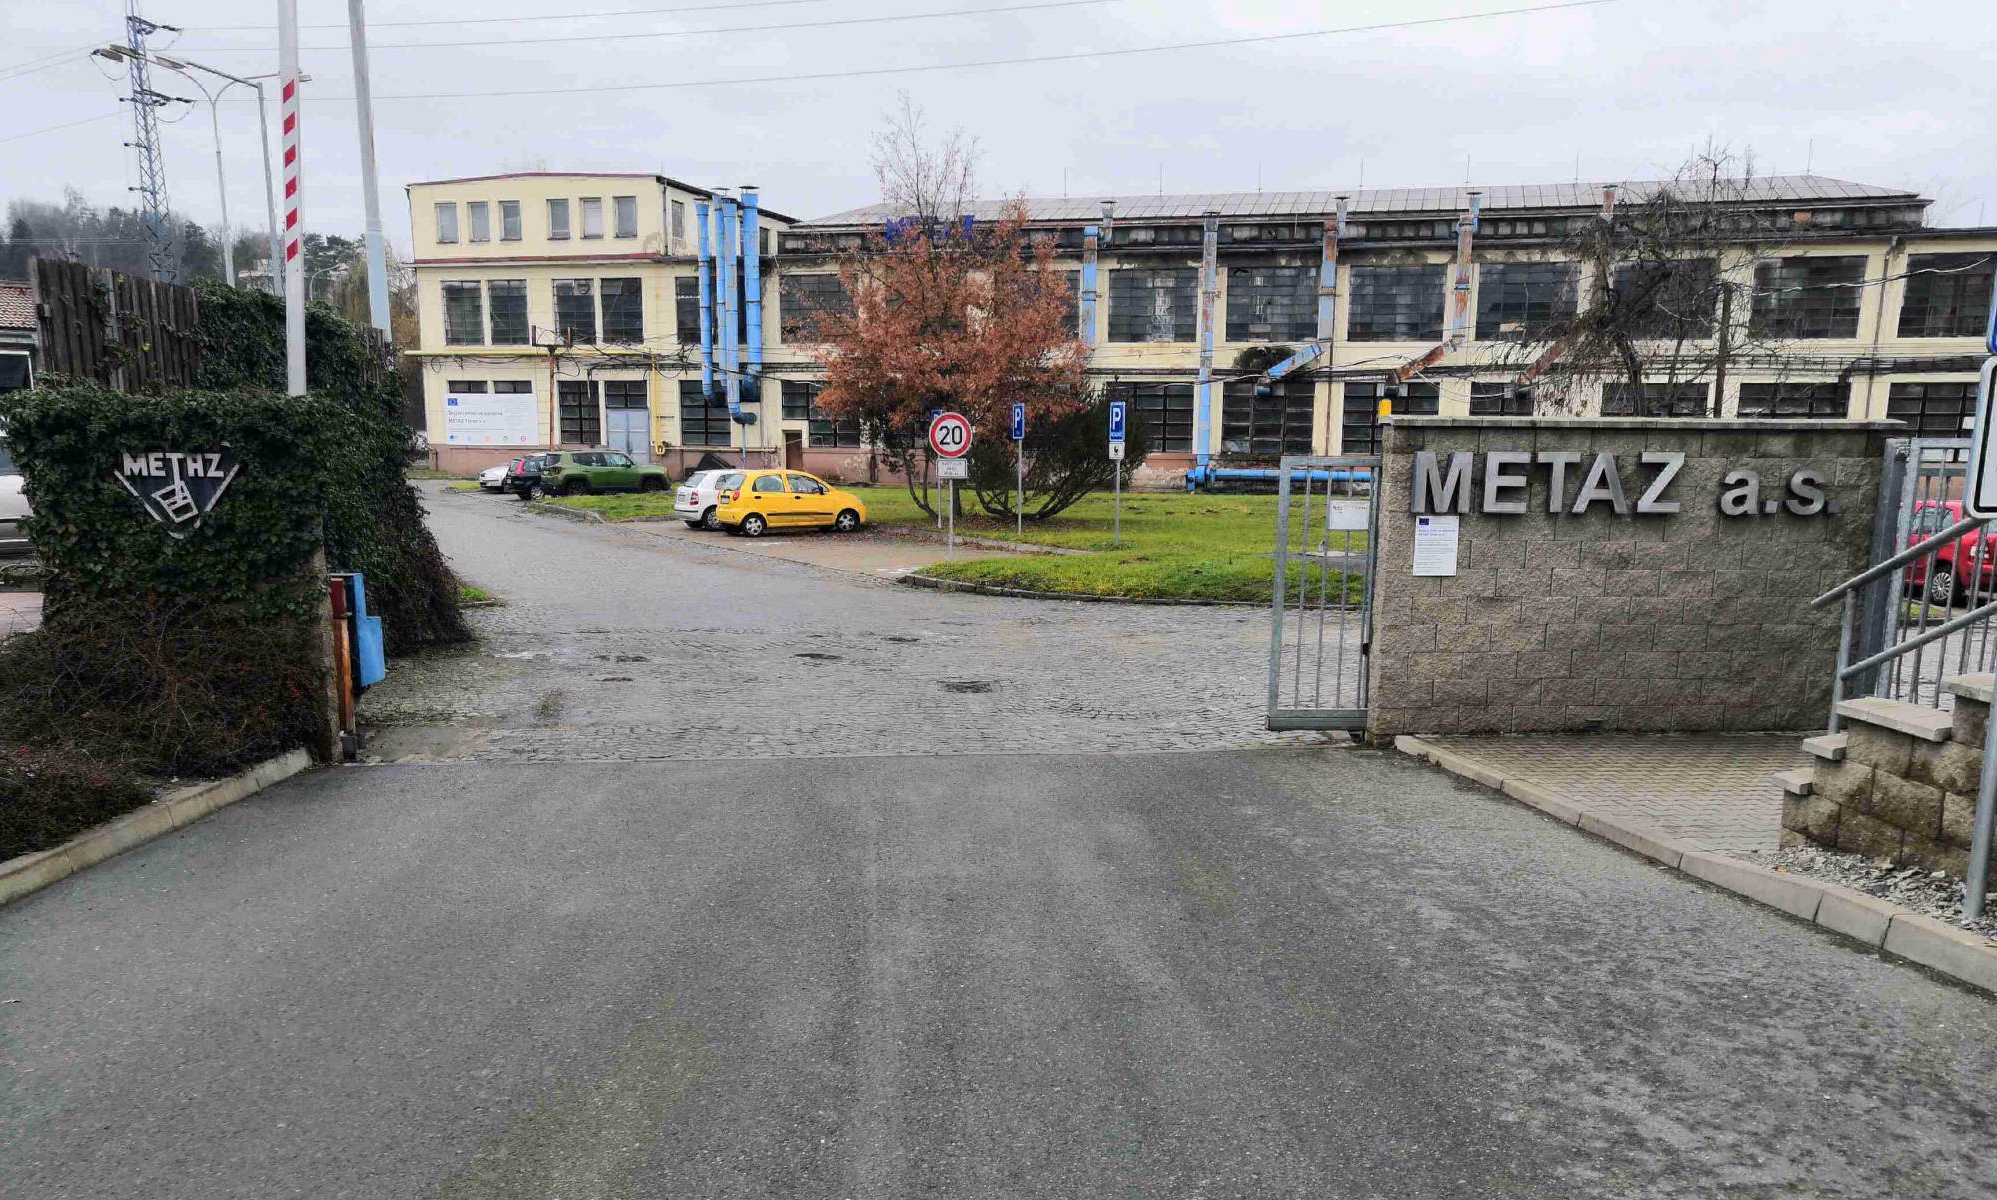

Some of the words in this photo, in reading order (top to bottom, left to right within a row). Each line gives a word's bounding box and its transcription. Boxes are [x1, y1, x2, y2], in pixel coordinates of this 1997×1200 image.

[1014, 408, 1022, 429] P
[1112, 407, 1122, 431] P
[939, 425, 963, 446] 20
[1410, 451, 1686, 514] METAZ
